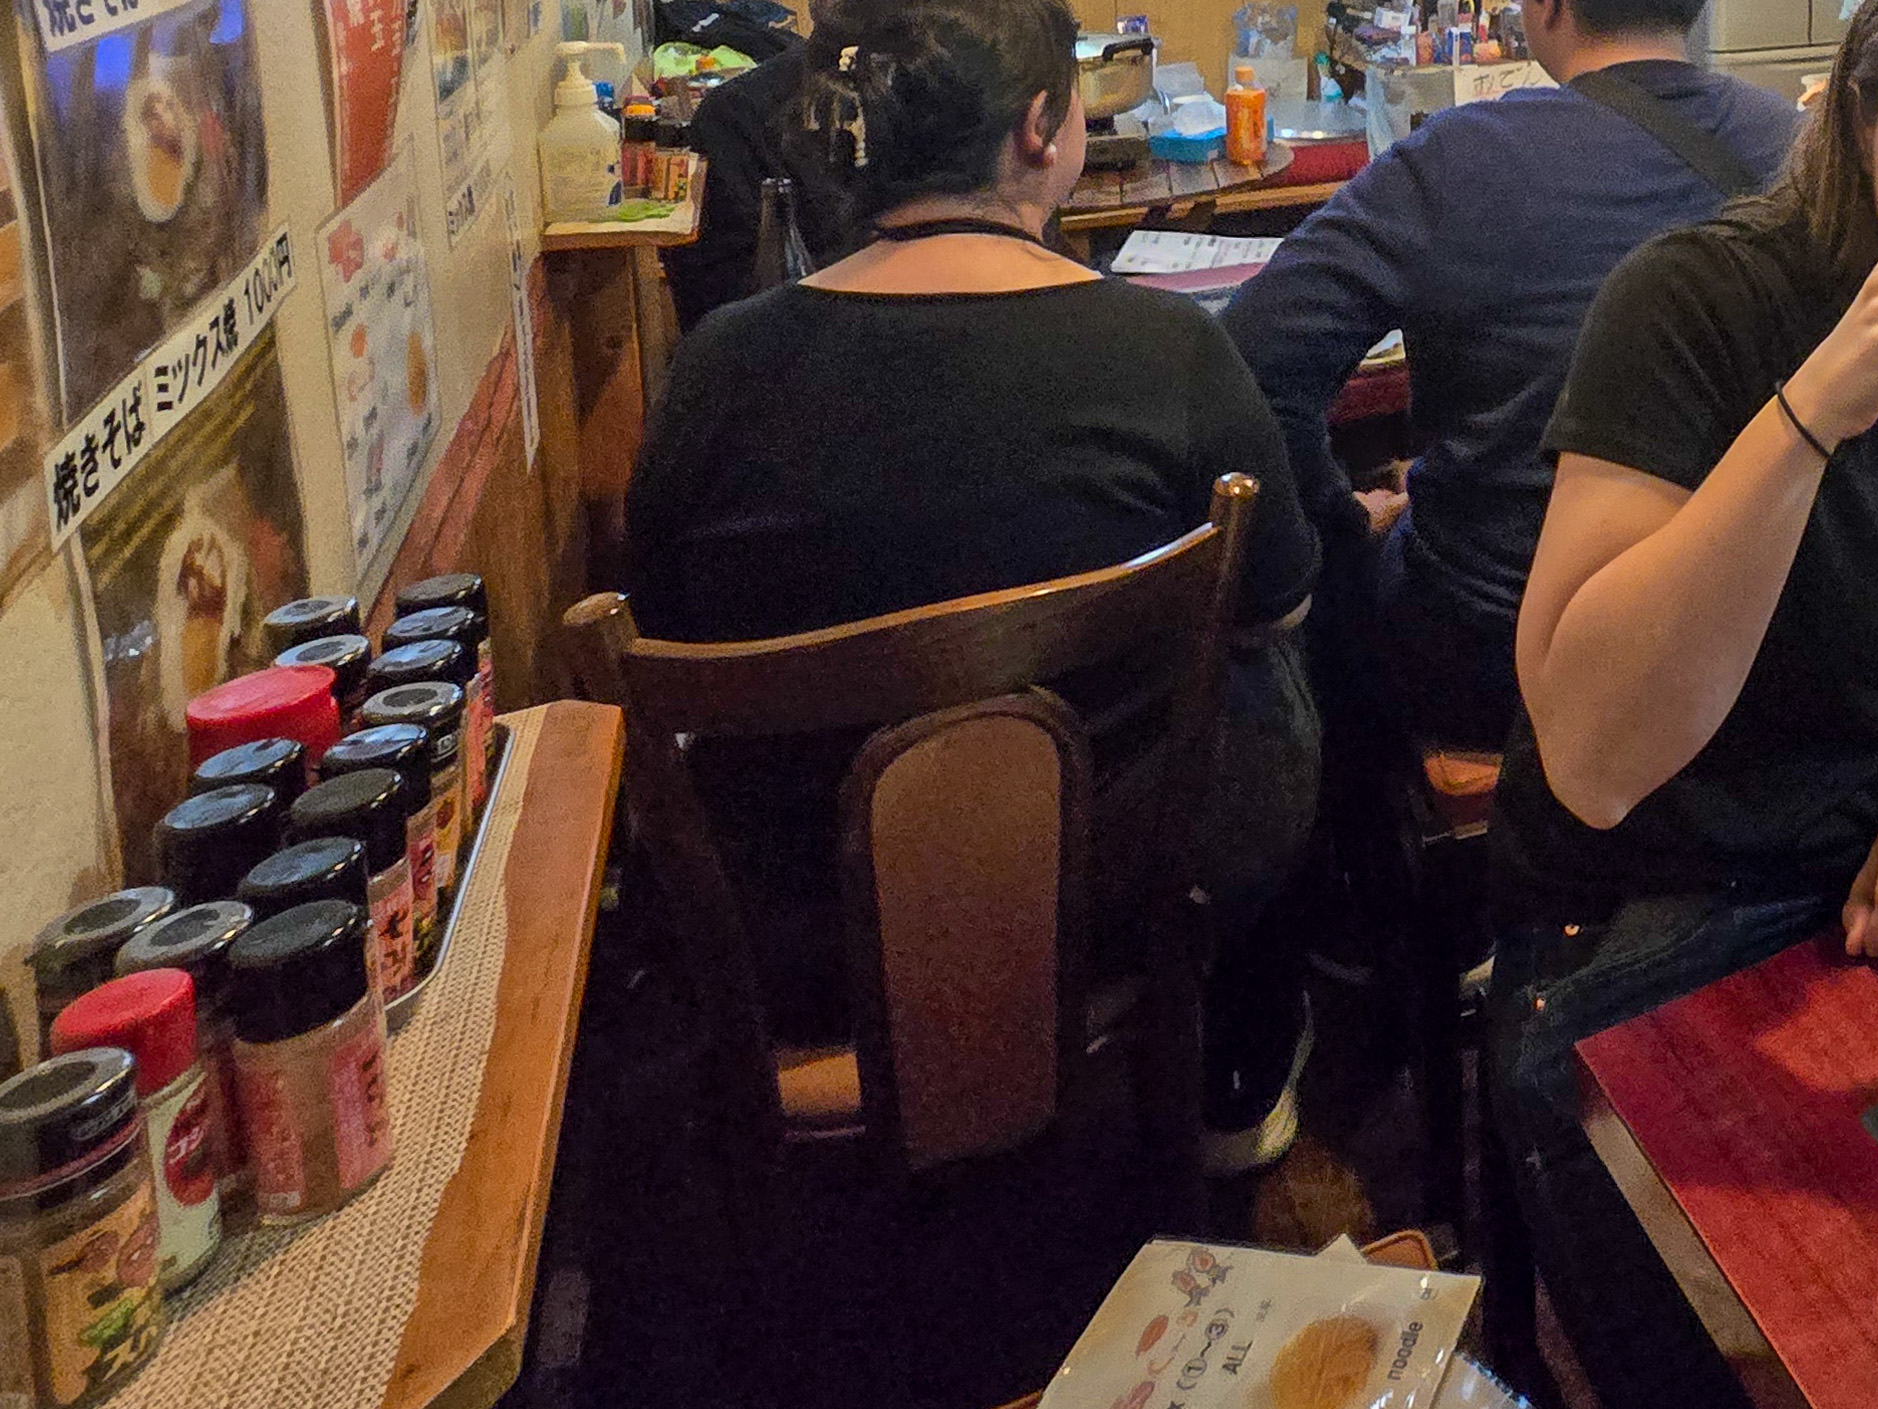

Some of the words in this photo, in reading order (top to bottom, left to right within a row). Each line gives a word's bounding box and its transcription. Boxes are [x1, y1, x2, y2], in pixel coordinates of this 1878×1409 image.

[53, 380, 147, 533] 焼きそば
[153, 297, 239, 412] ミックス焼
[1221, 1340, 1254, 1376] ALL
